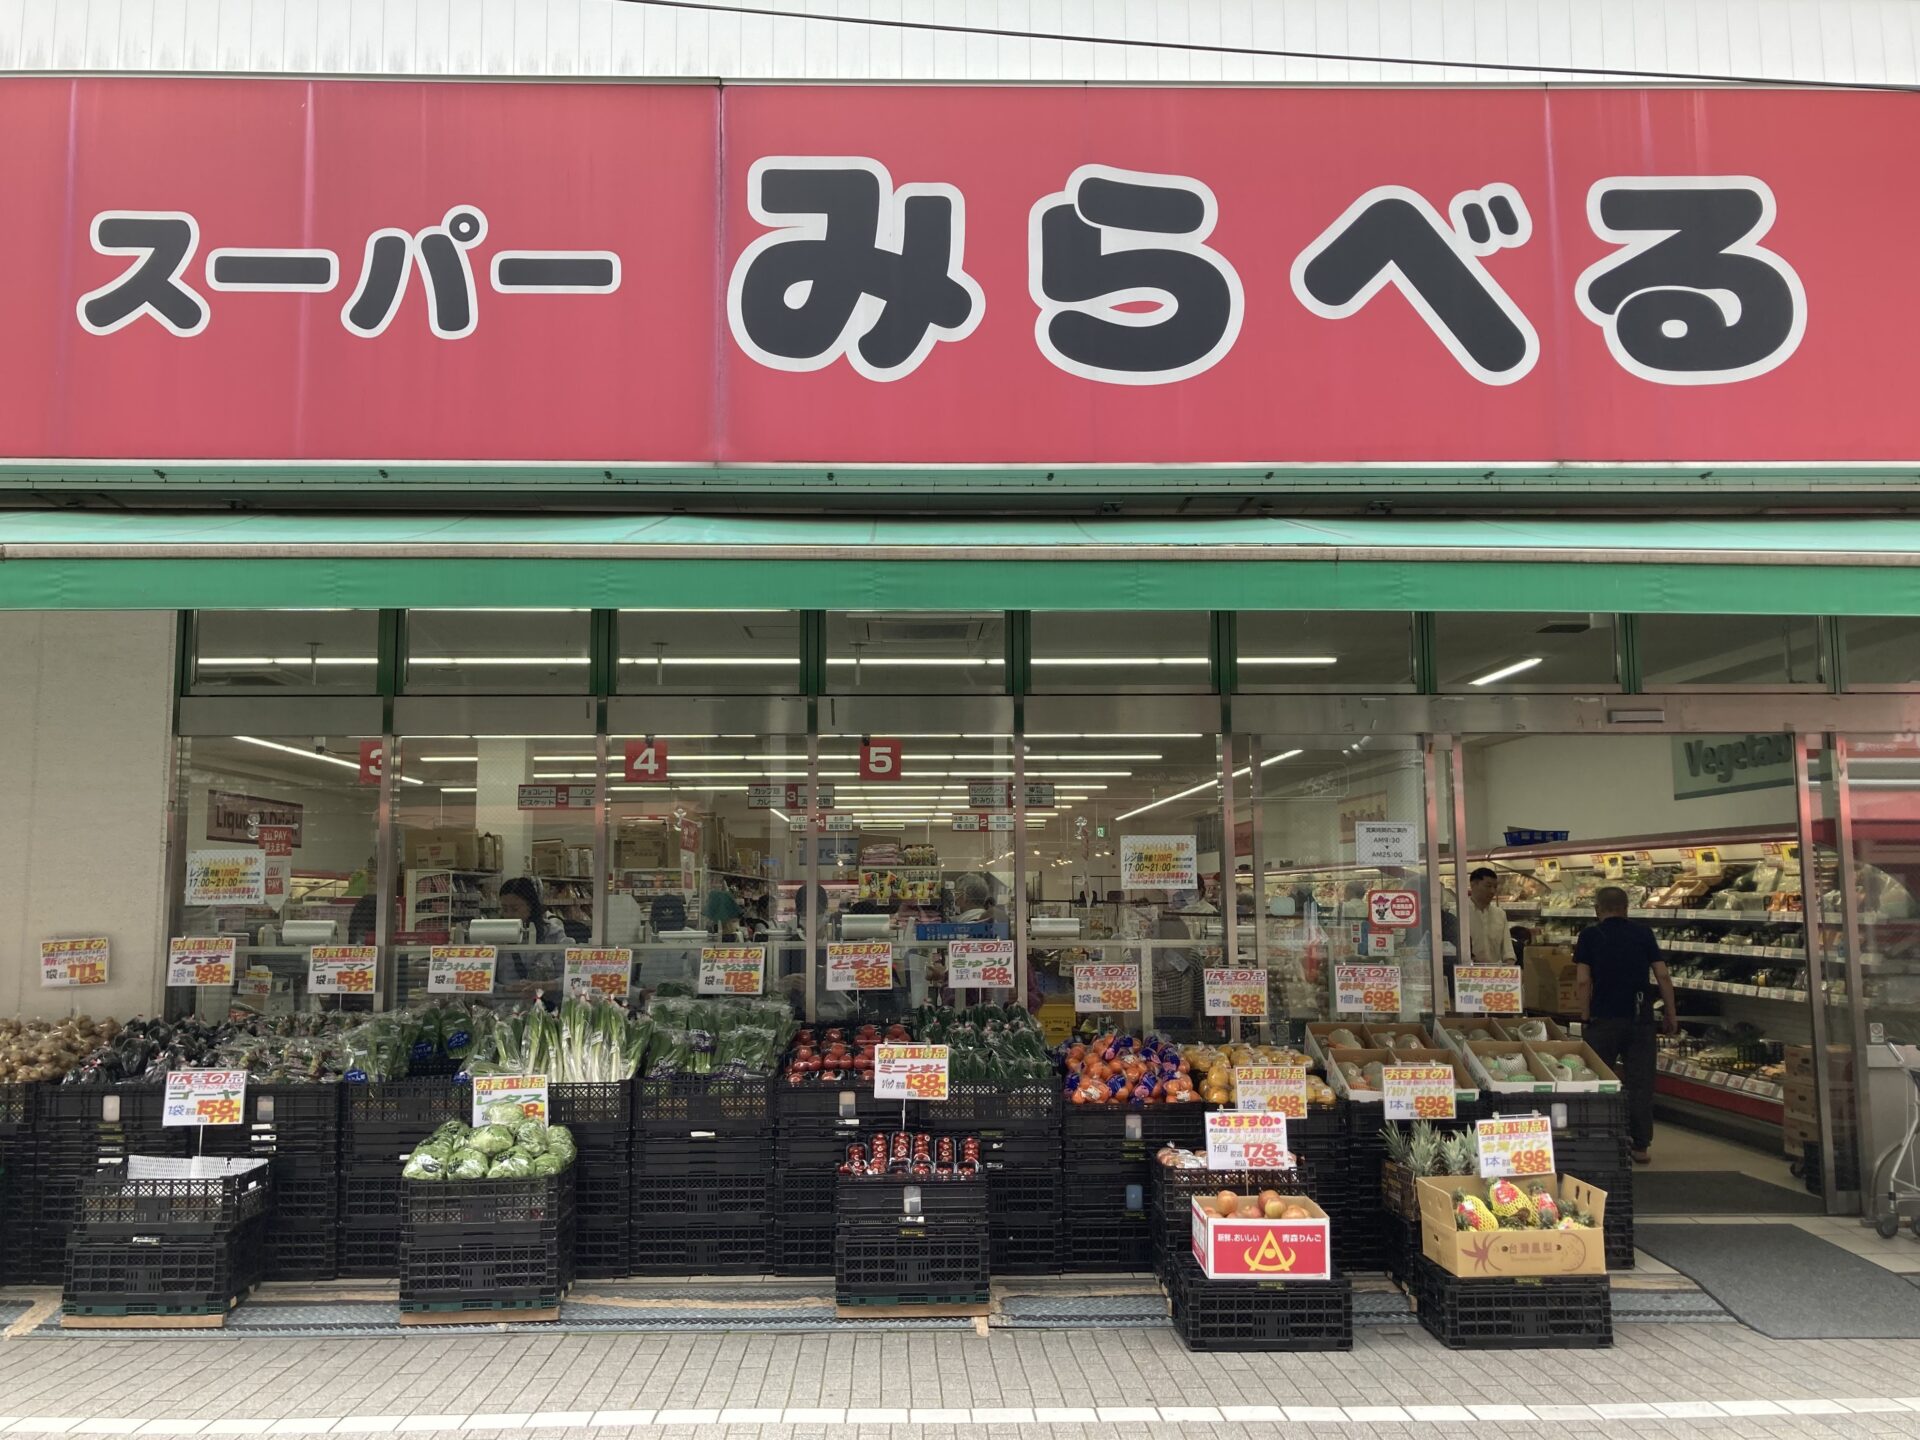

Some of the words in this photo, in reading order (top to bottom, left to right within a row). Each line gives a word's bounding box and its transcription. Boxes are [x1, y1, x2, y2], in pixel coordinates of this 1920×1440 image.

[77, 204, 622, 341] スーパー
[728, 156, 1808, 386] みらべる
[633, 748, 659, 775] 4
[869, 747, 893, 773] 5
[521, 788, 554, 796] チョコレート
[558, 792, 567, 803] 5
[787, 791, 796, 802] 3
[980, 818, 988, 827] 2
[274, 830, 287, 840] PAY
[268, 879, 280, 889] PAY
[44, 940, 106, 951] おすすめ
[173, 940, 232, 950] お買い得品!
[829, 944, 890, 955] おすすめ!
[953, 943, 1012, 953] 広告の品
[312, 948, 375, 958] お買い得品
[433, 948, 494, 958] おすすめ
[568, 951, 629, 960] お買い得品
[704, 949, 763, 959] おすすめ
[174, 955, 231, 965] なす
[832, 958, 889, 969] とまと
[952, 957, 1011, 968] きゅうり
[432, 961, 492, 971] ほうれん草
[702, 963, 761, 972] 小松菜
[455, 970, 490, 984] 128円
[981, 967, 1012, 980] 128円
[1078, 967, 1137, 977] 広告の品
[1206, 971, 1266, 981] 広告の品
[1337, 968, 1400, 978] 広告の品
[1456, 968, 1520, 978] おすすめ!
[336, 971, 373, 985] 158円
[591, 973, 627, 988] 158円
[724, 972, 760, 986] 118円
[1077, 981, 1137, 990] ミネオラオレンジ
[1339, 982, 1399, 991] 赤肉メロン
[1458, 983, 1519, 993] 青肉メロン
[1101, 989, 1137, 1004] 398円
[1230, 994, 1265, 1008] 398円
[1363, 990, 1399, 1005] 698円
[1483, 992, 1520, 1005] 698円
[879, 1048, 947, 1059] お買い得品
[879, 1064, 946, 1074] ミニとまと
[1238, 1068, 1304, 1080] お買い得品
[1386, 1069, 1451, 1080] おすすめ!
[169, 1072, 245, 1085] 広告の品
[476, 1078, 545, 1090] お買い得品
[906, 1074, 946, 1089] 138円
[168, 1089, 242, 1101] ゴーヤ
[475, 1094, 545, 1106] レタス
[197, 1100, 240, 1116] 158円
[1267, 1096, 1305, 1109] 498円
[1389, 1099, 1405, 1110] 1本
[1414, 1095, 1454, 1110] 598円
[1217, 1115, 1274, 1128] おすすめ
[1480, 1121, 1548, 1136] お買い得品!
[1242, 1142, 1284, 1158] 178円
[1247, 1157, 1285, 1168] 193円
[1485, 1156, 1501, 1167] 1本
[1511, 1150, 1552, 1166] 498円
[1281, 1232, 1322, 1243] 青森りんご
